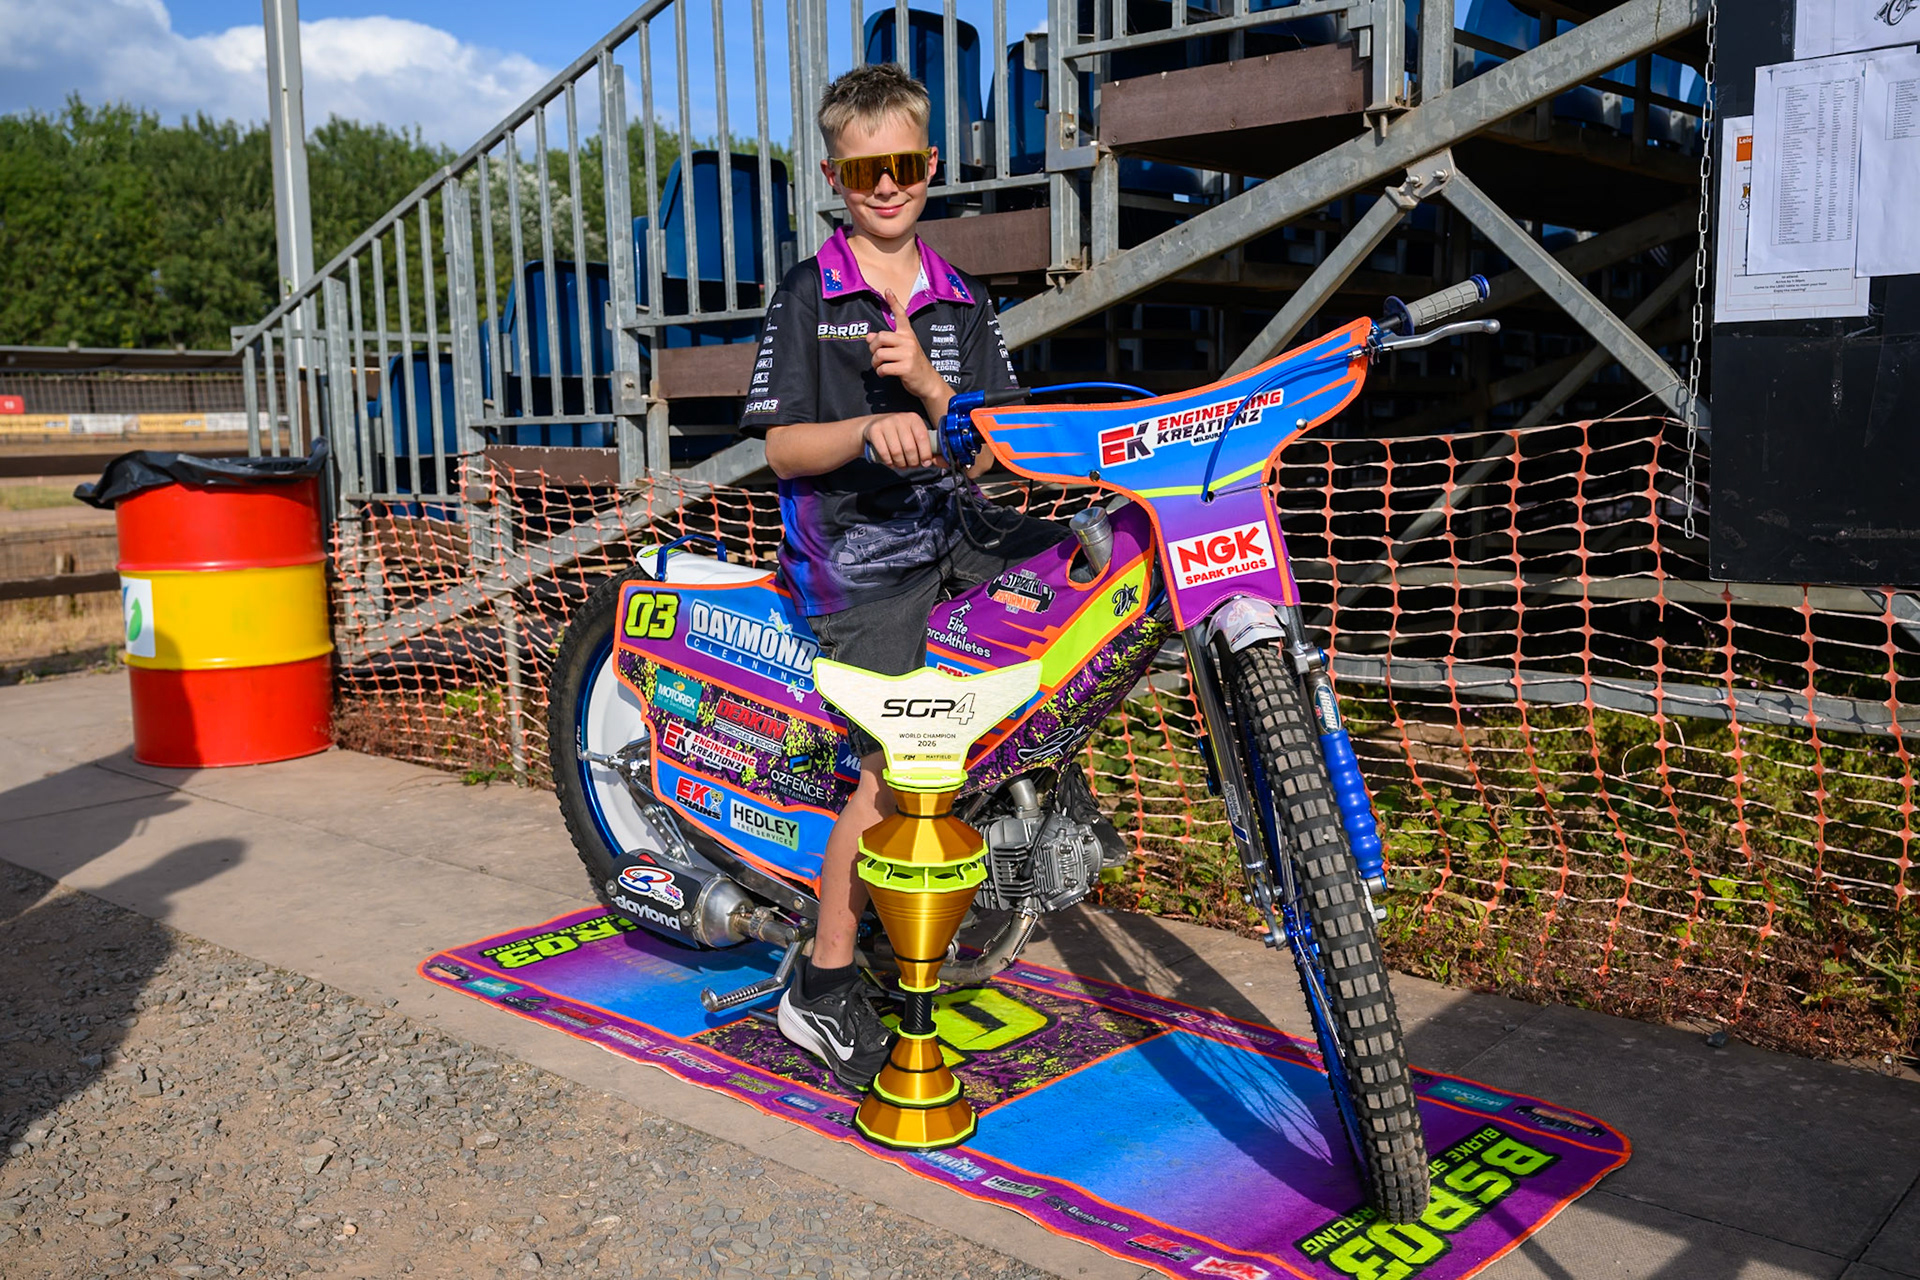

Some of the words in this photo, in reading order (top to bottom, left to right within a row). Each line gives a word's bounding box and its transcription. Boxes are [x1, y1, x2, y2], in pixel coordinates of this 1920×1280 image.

[817, 322, 869, 337] BSR03
[941, 374, 962, 385] DLEY
[1101, 422, 1153, 467] EK
[1193, 432, 1224, 444] MILDUR
[1176, 526, 1266, 574] NGK
[1185, 568, 1224, 585] SPARK
[1226, 558, 1267, 577] PLUGS
[624, 591, 680, 639] 03
[946, 615, 968, 635] Elite
[692, 603, 819, 674] DAYMOND
[927, 627, 991, 658] orceAthletes
[694, 638, 806, 687] CLEANING
[657, 683, 697, 710] MOTOREX
[881, 692, 976, 725] SGP4
[715, 699, 787, 741] DEAKIN
[715, 721, 750, 740] MOTORCYCLES
[664, 722, 692, 753] EK
[693, 734, 757, 766] ENGINEERING
[690, 742, 742, 771] KREATIONZ
[676, 777, 711, 806] EK
[770, 769, 825, 800] OZFENCE
[779, 785, 817, 804] RETAINING
[676, 795, 721, 820] CHAINS
[733, 803, 797, 838] HEDLEY
[737, 822, 755, 835] TREE
[755, 828, 793, 847] SERVICES
[615, 894, 681, 930] daytona
[1442, 1128, 1502, 1164] BLAKE
[922, 1150, 986, 1177] YMOND
[1301, 1206, 1377, 1256] RACING
